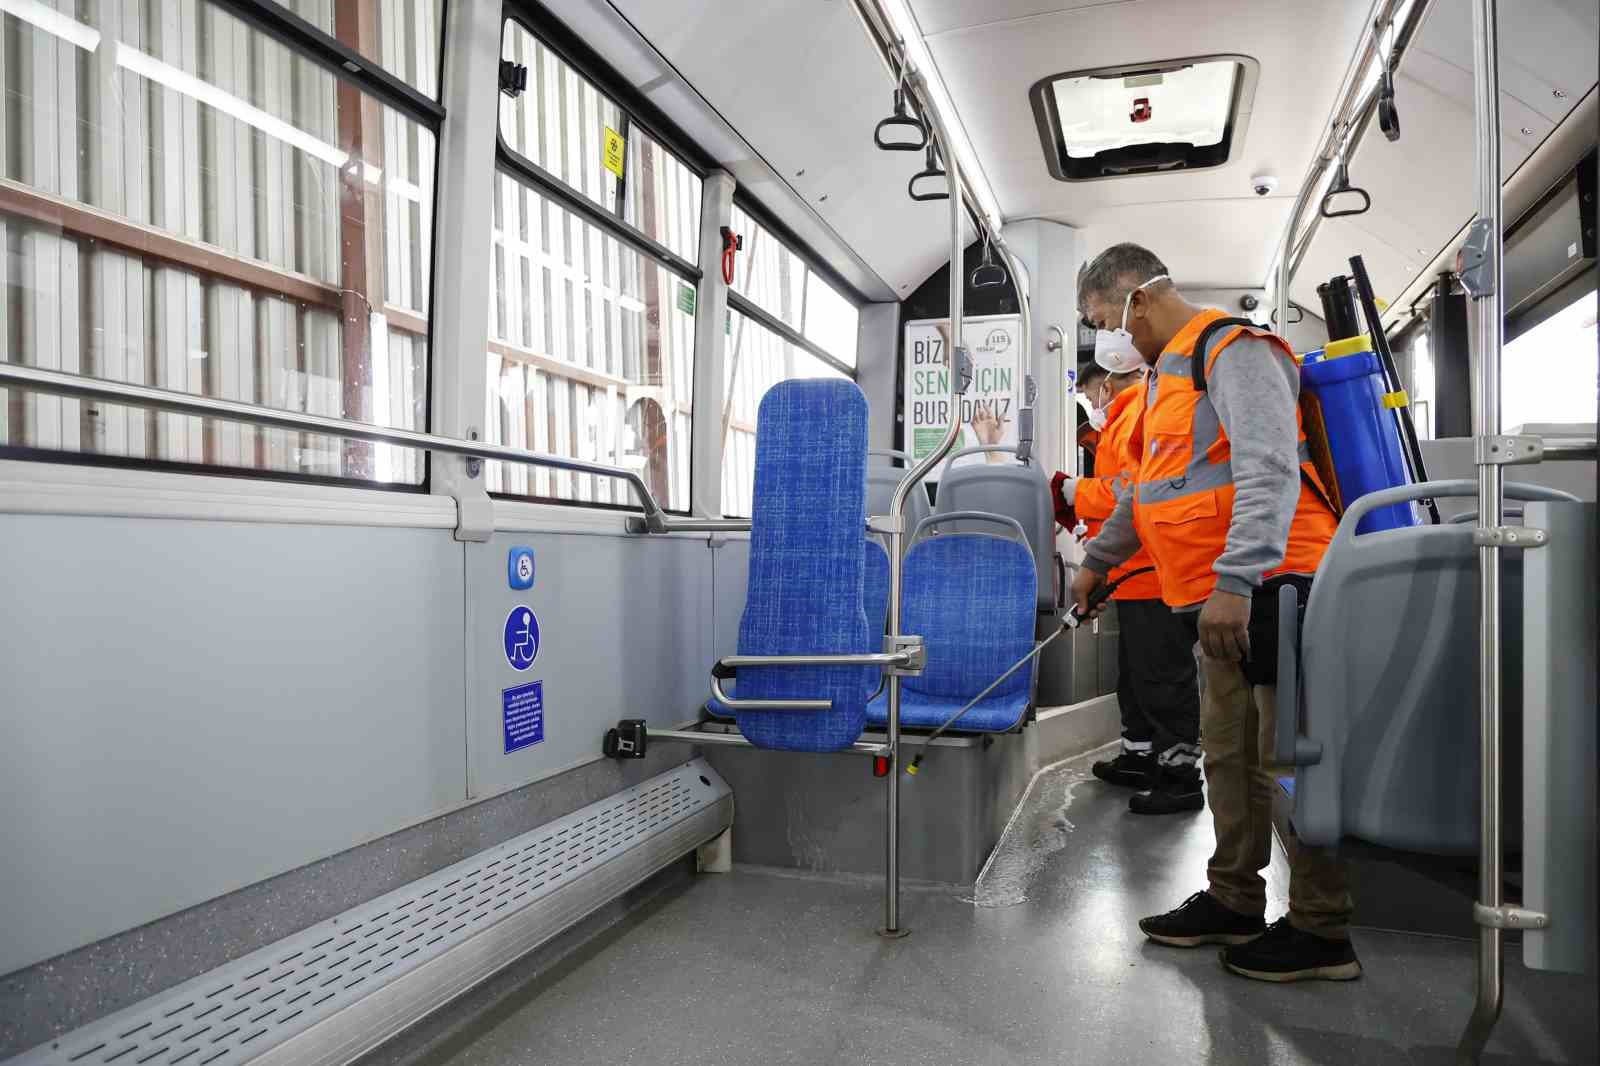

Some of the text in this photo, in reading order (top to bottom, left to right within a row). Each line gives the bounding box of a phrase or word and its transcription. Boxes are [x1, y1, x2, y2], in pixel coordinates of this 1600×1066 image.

[914, 336, 942, 364] BİZ
[975, 364, 1011, 396] İÇİN
[914, 398, 1011, 424] BURDAYIZ
